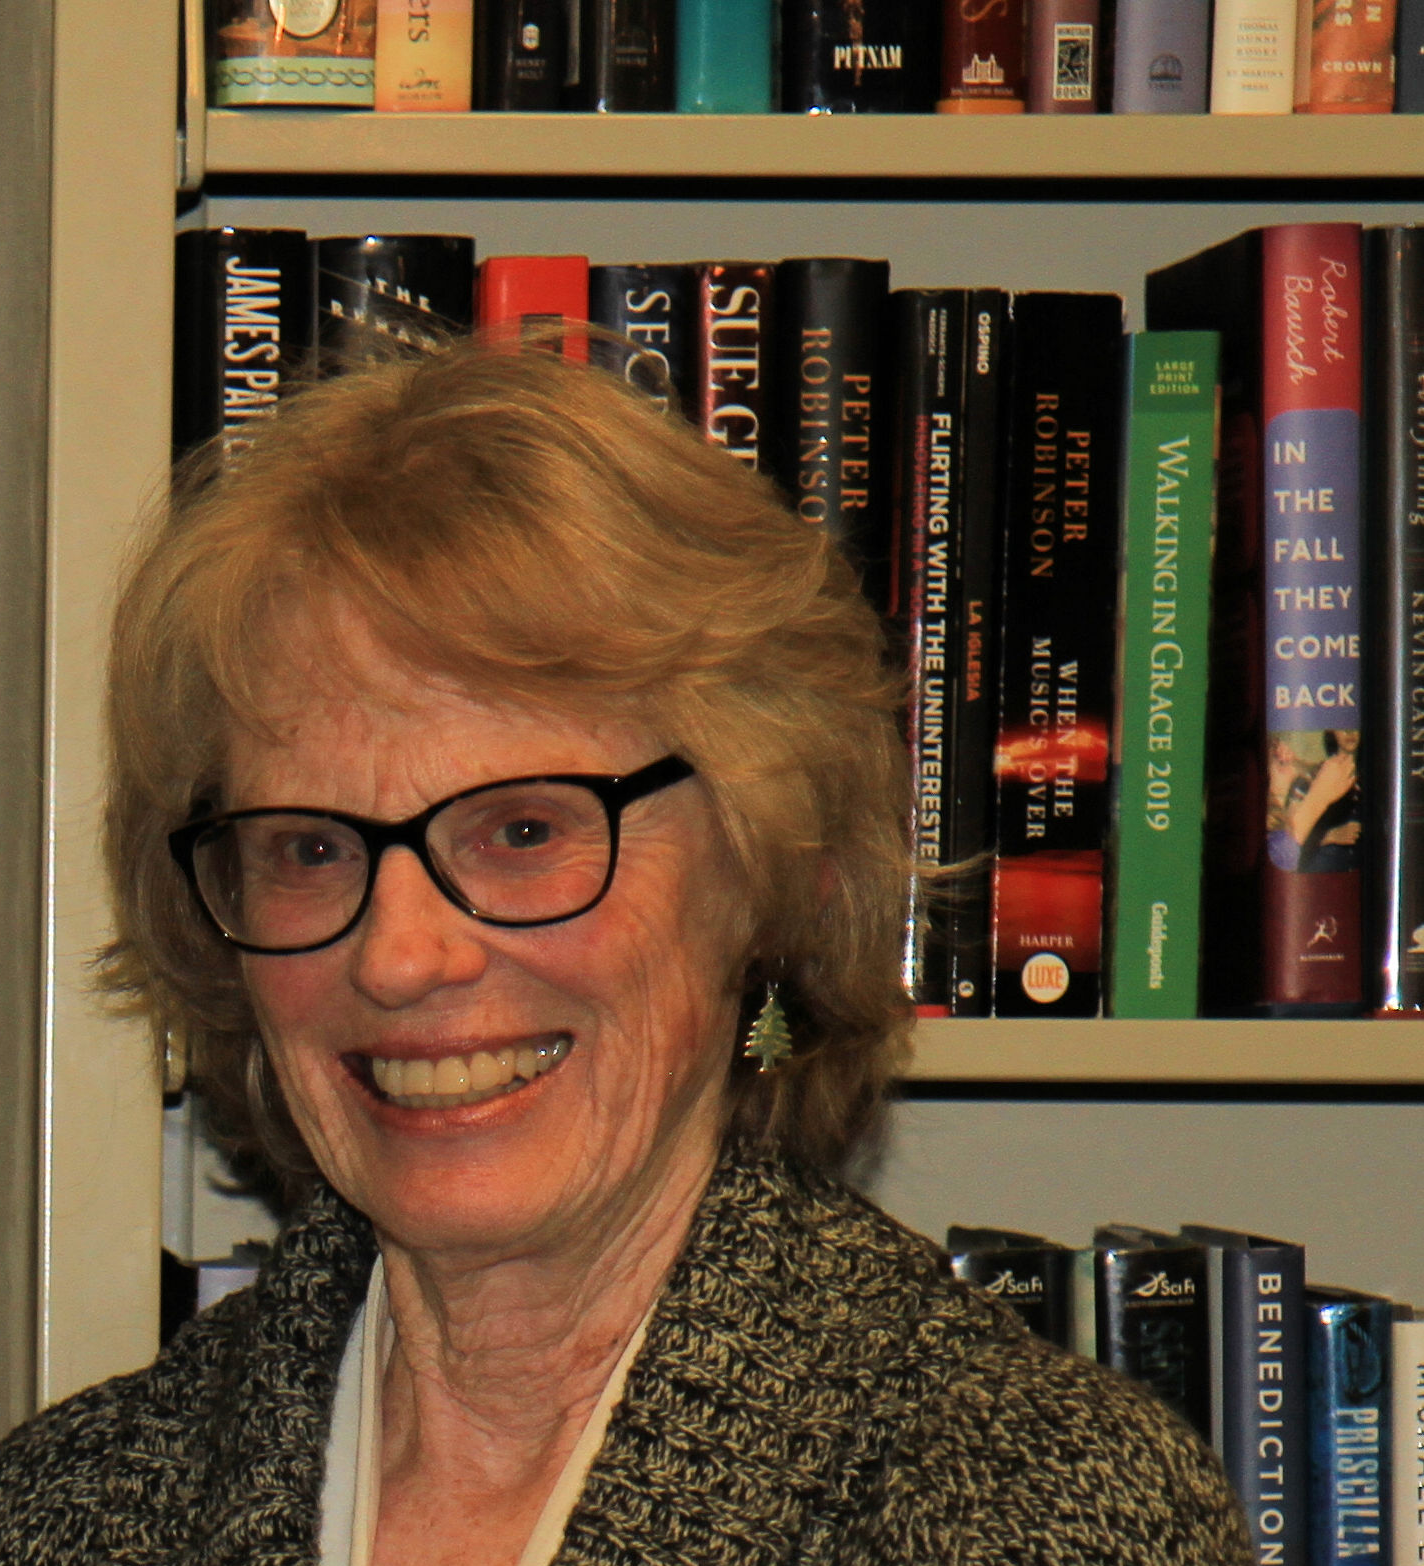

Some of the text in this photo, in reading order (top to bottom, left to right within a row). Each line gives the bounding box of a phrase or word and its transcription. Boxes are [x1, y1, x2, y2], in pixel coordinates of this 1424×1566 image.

[834, 45, 902, 69] PUTNAM
[1322, 61, 1382, 73] CROWN
[223, 256, 281, 363] JAMES
[374, 277, 432, 313] THE
[1283, 275, 1318, 385] Bausch
[1319, 256, 1349, 363] Robert
[625, 290, 671, 414] SEC
[708, 285, 761, 391] SUE
[977, 312, 992, 375] OSPINO
[1156, 361, 1195, 371] LARGE
[1156, 373, 1194, 383] PRINT
[797, 328, 832, 523] ROBINSO
[1149, 384, 1200, 394] EDITION
[840, 374, 871, 511] PETER
[928, 412, 952, 534] FLIRTING
[1273, 441, 1306, 464] IN
[1030, 393, 1060, 578] ROBINSON
[1063, 431, 1091, 542] PETER
[1273, 489, 1335, 513] THE
[926, 541, 948, 613] WITH
[1273, 538, 1344, 562] FALL
[1145, 435, 1190, 831] WALKING IN GRACE 2019
[1273, 586, 1353, 611] THEY
[925, 618, 947, 671] THE
[966, 600, 984, 702] LA IGLESIA
[1274, 635, 1361, 659] COME
[1274, 683, 1356, 709] BACK
[1026, 637, 1052, 840] MUSIC'S OVER
[1054, 660, 1079, 817] WHEN THE
[1019, 934, 1074, 947] HARPER
[1027, 965, 1064, 989] LUXE
[1147, 902, 1168, 990] Guideposts
[1257, 1272, 1285, 1566] BENEDICTION
[1335, 1406, 1380, 1557] PRISCILLA
